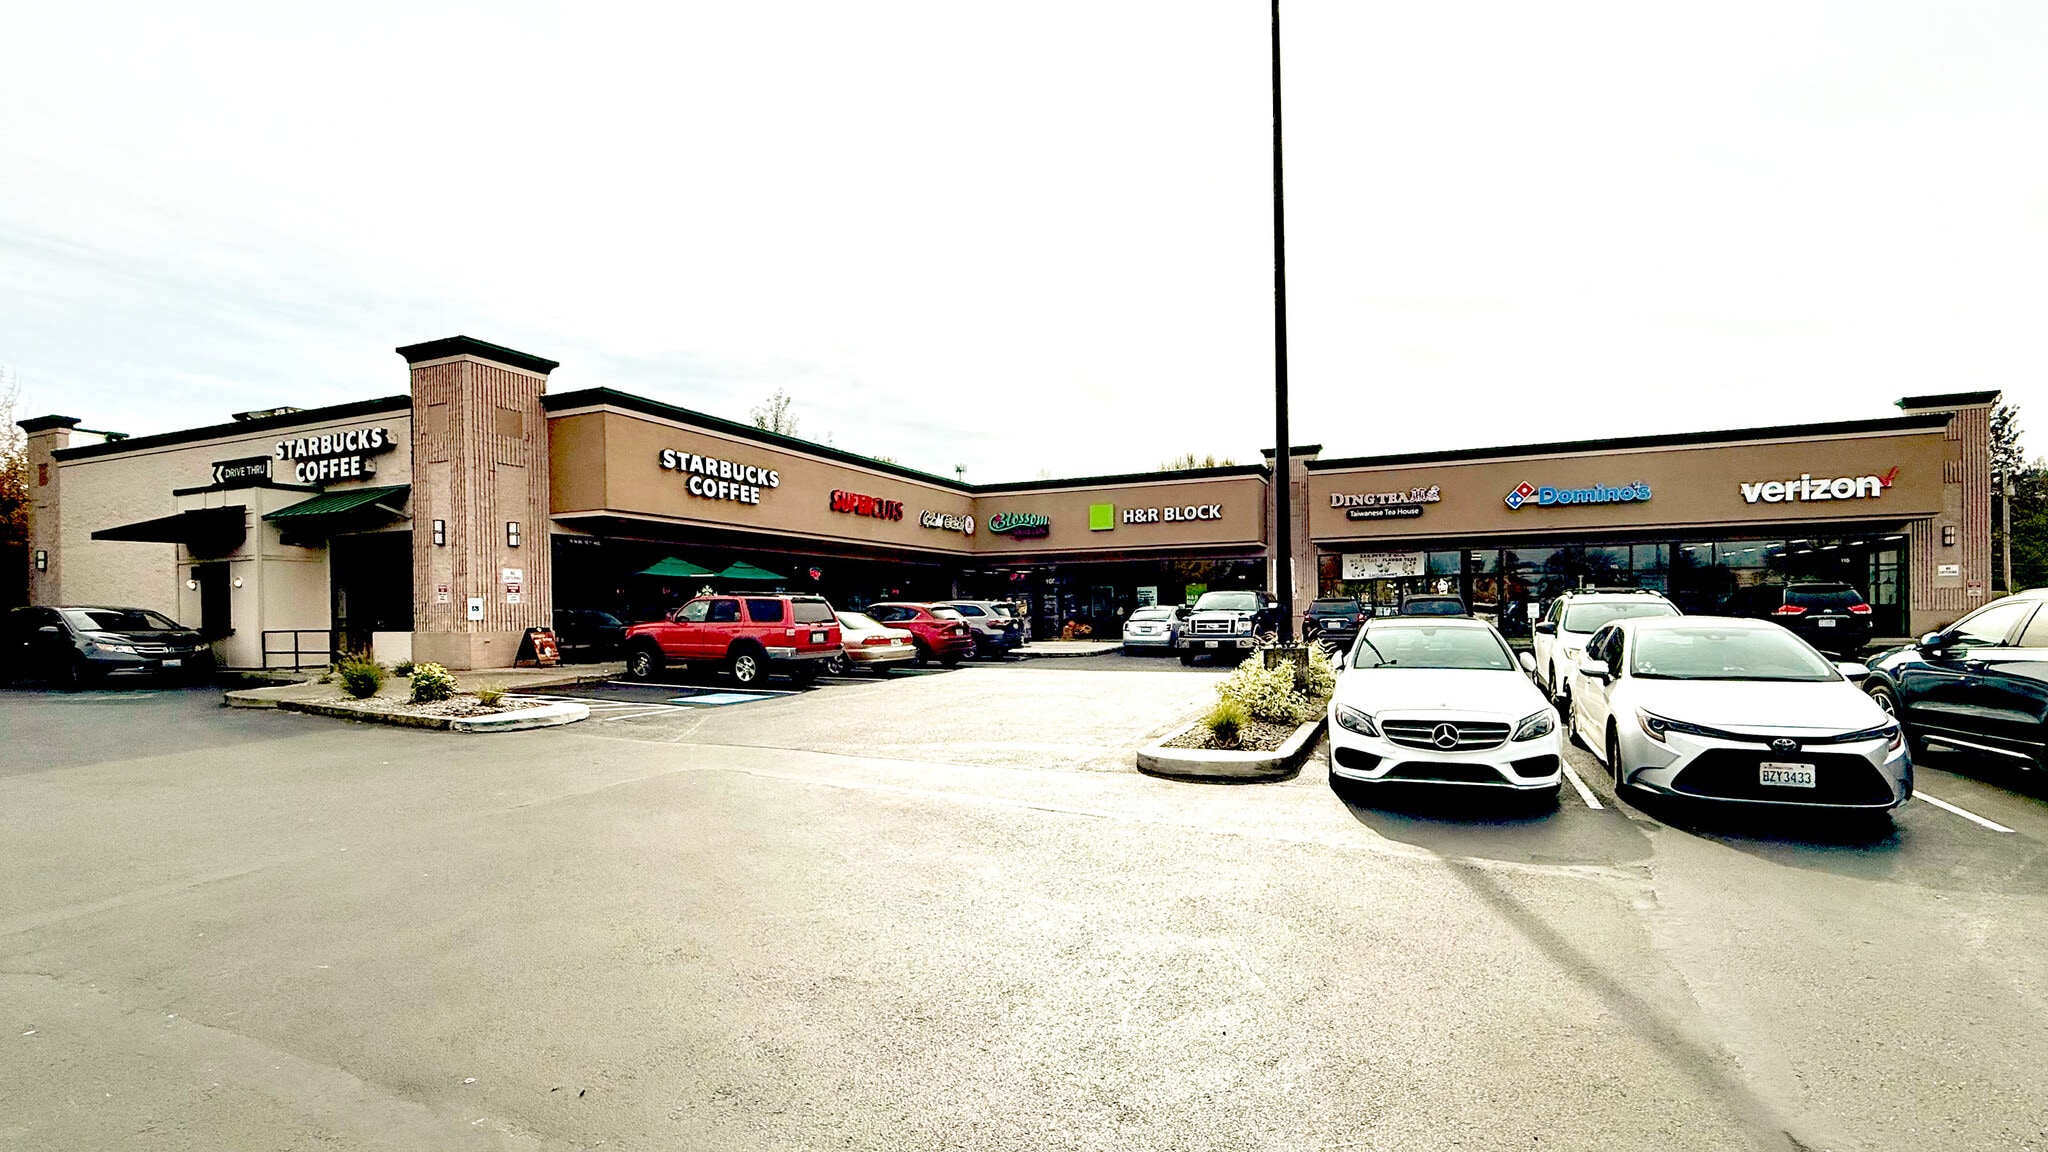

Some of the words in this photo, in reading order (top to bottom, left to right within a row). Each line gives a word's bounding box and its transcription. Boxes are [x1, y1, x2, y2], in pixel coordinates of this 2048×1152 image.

[275, 428, 382, 460] STARBUCKS
[225, 466, 246, 479] DRIVE
[247, 464, 266, 476] THRU
[295, 456, 361, 482] COFFEE
[662, 448, 780, 488] STARBUCKS
[689, 475, 760, 504] COFFEE
[1538, 481, 1652, 504] Domino's
[1740, 473, 1882, 503] verizon
[830, 489, 904, 522] SUPERCUTS
[1123, 508, 1159, 523] H&R
[1164, 504, 1222, 521] BLOCK
[1350, 509, 1384, 517] Taiwanese
[1384, 508, 1396, 516] Tea
[1397, 507, 1420, 515] House
[988, 512, 1050, 532] Blossom
